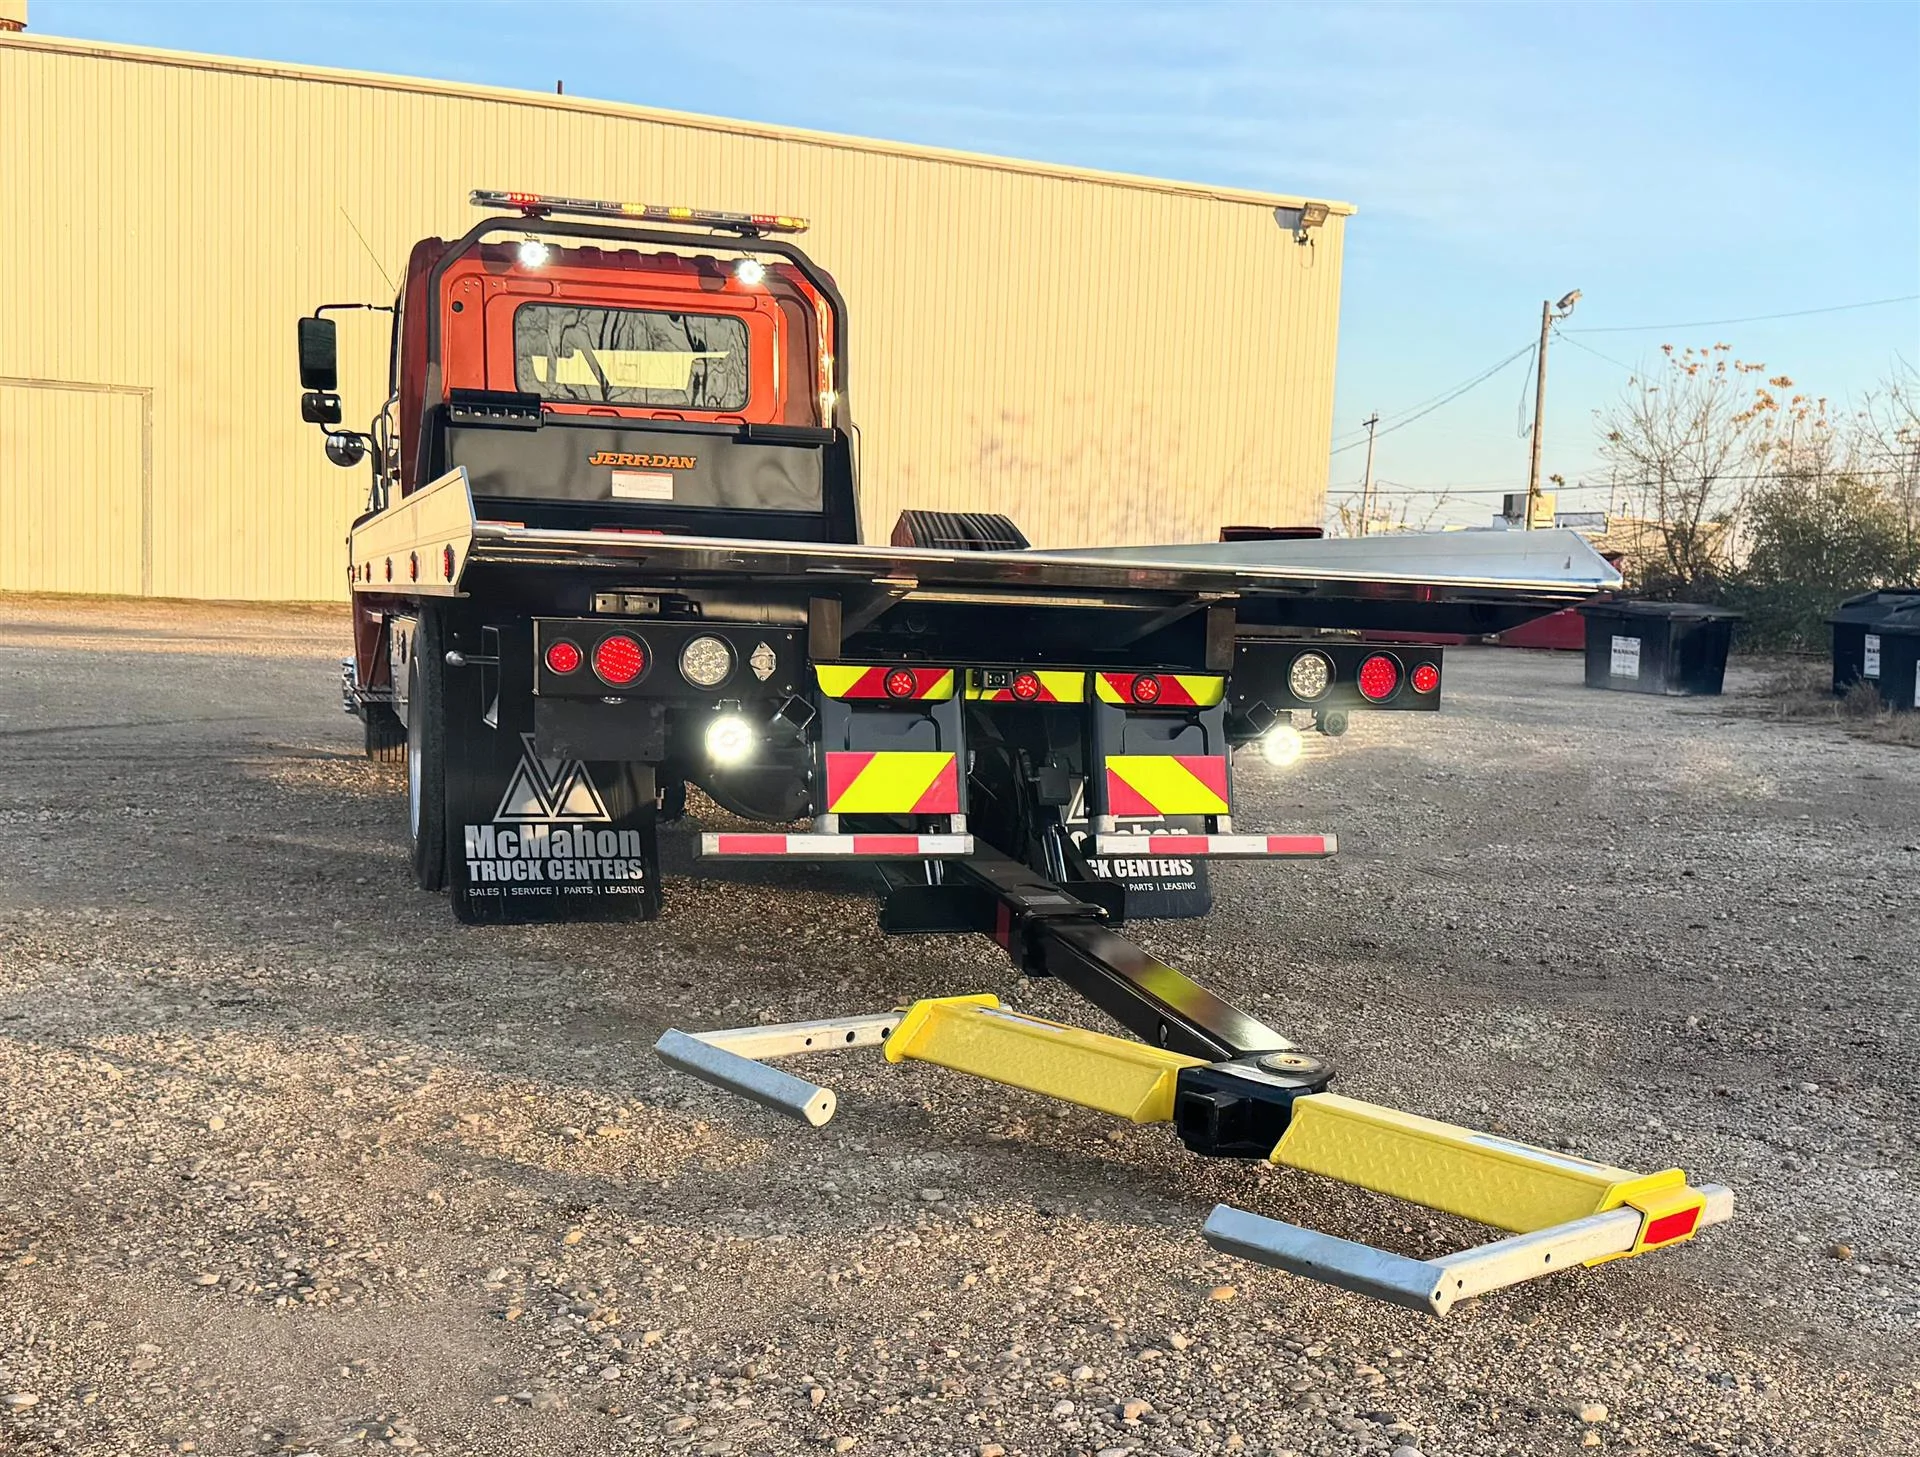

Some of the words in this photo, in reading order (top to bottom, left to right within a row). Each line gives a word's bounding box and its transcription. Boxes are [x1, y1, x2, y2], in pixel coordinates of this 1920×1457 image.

[464, 825, 642, 859] McMahon
[466, 861, 544, 882] TRUCK
[547, 858, 643, 880] CENTERS
[1113, 859, 1194, 878] CENTERS
[468, 887, 500, 897] SALES
[511, 887, 552, 896] SERVICE
[564, 886, 594, 895] PARTS
[604, 885, 645, 895] LEASING
[1129, 882, 1154, 892] PARTS
[1162, 881, 1197, 891] LEASING
